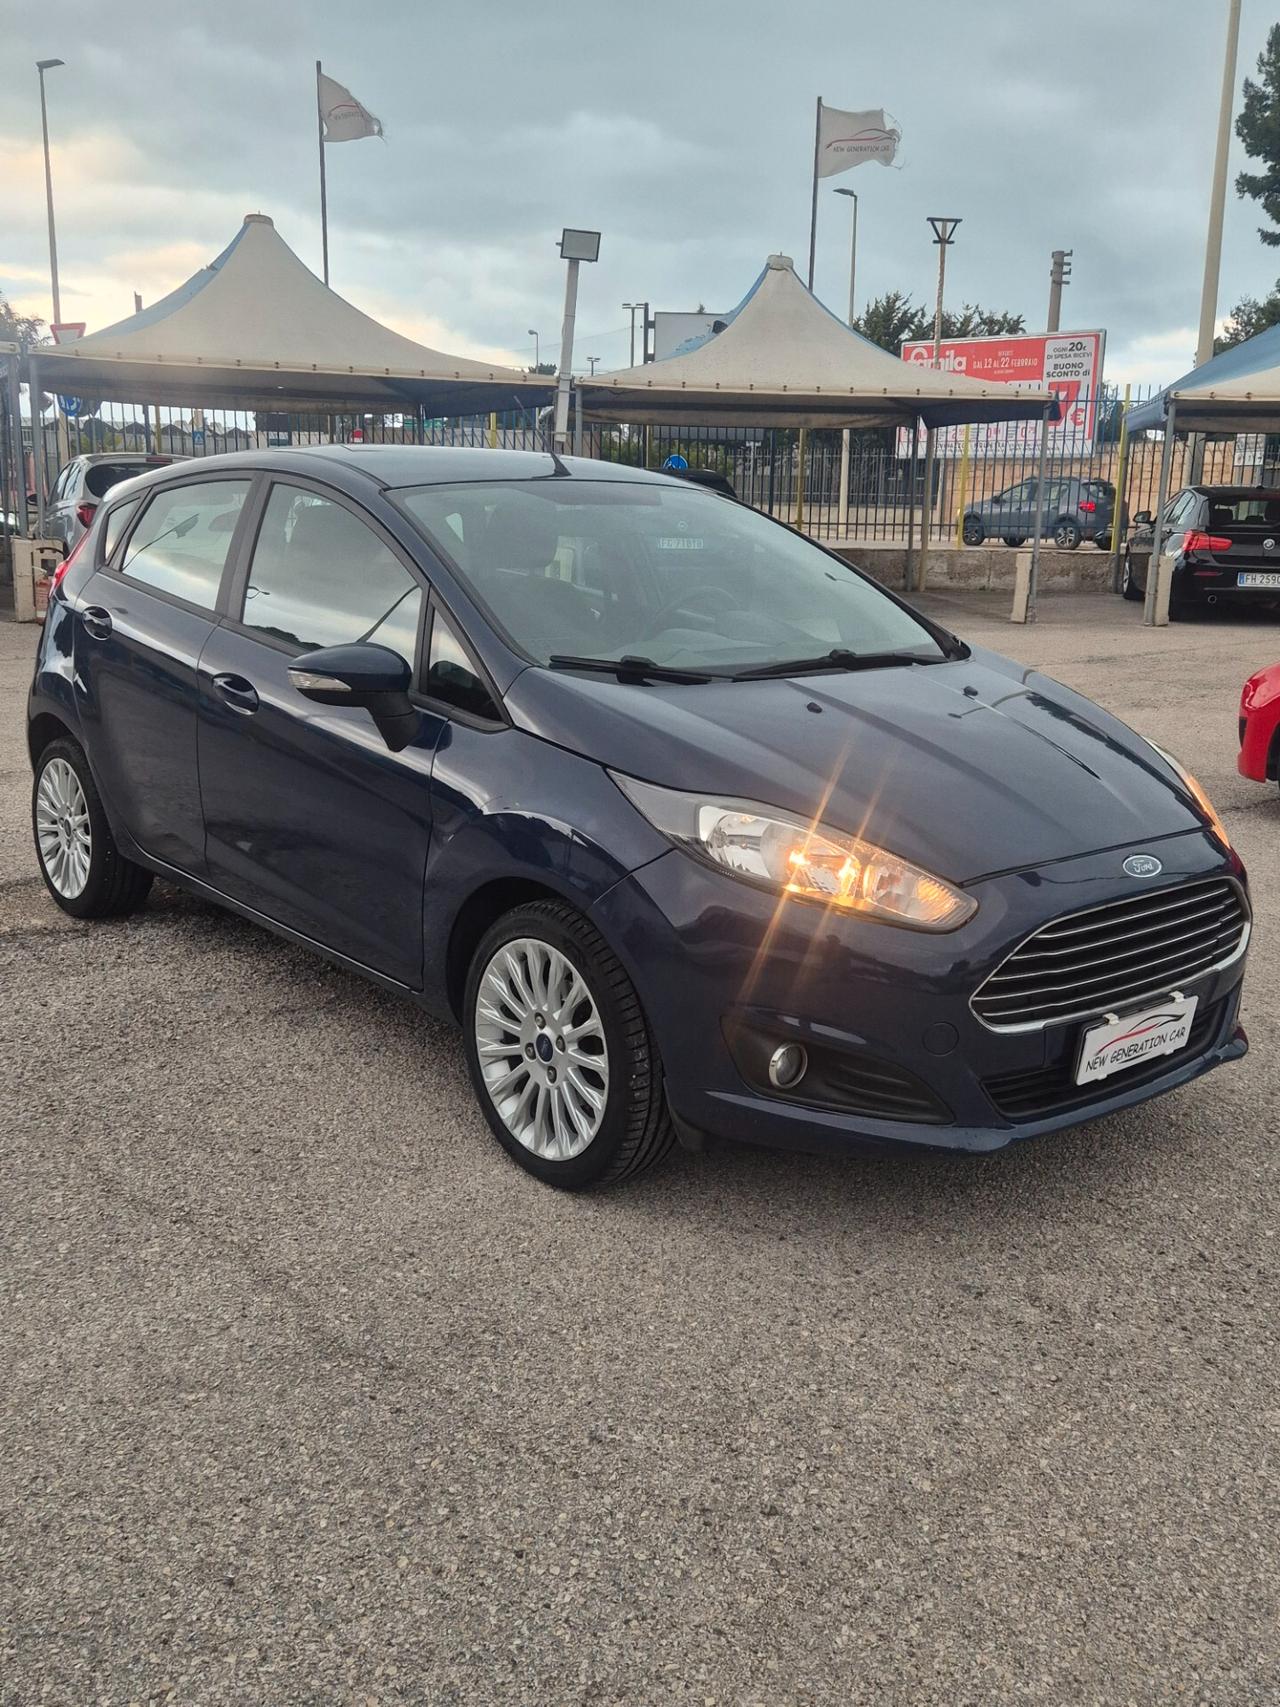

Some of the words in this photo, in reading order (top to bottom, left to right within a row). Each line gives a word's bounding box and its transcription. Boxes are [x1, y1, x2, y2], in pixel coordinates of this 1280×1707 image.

[983, 357, 992, 369] 12
[1000, 356, 1010, 368] 22
[1053, 361, 1084, 370] BUONO
[1046, 370, 1080, 378] SCONTO
[1245, 574, 1257, 583] FH
[1086, 1054, 1108, 1072] NEW
[1110, 1033, 1168, 1063] GENERATION
[1169, 1026, 1186, 1042] CAR
